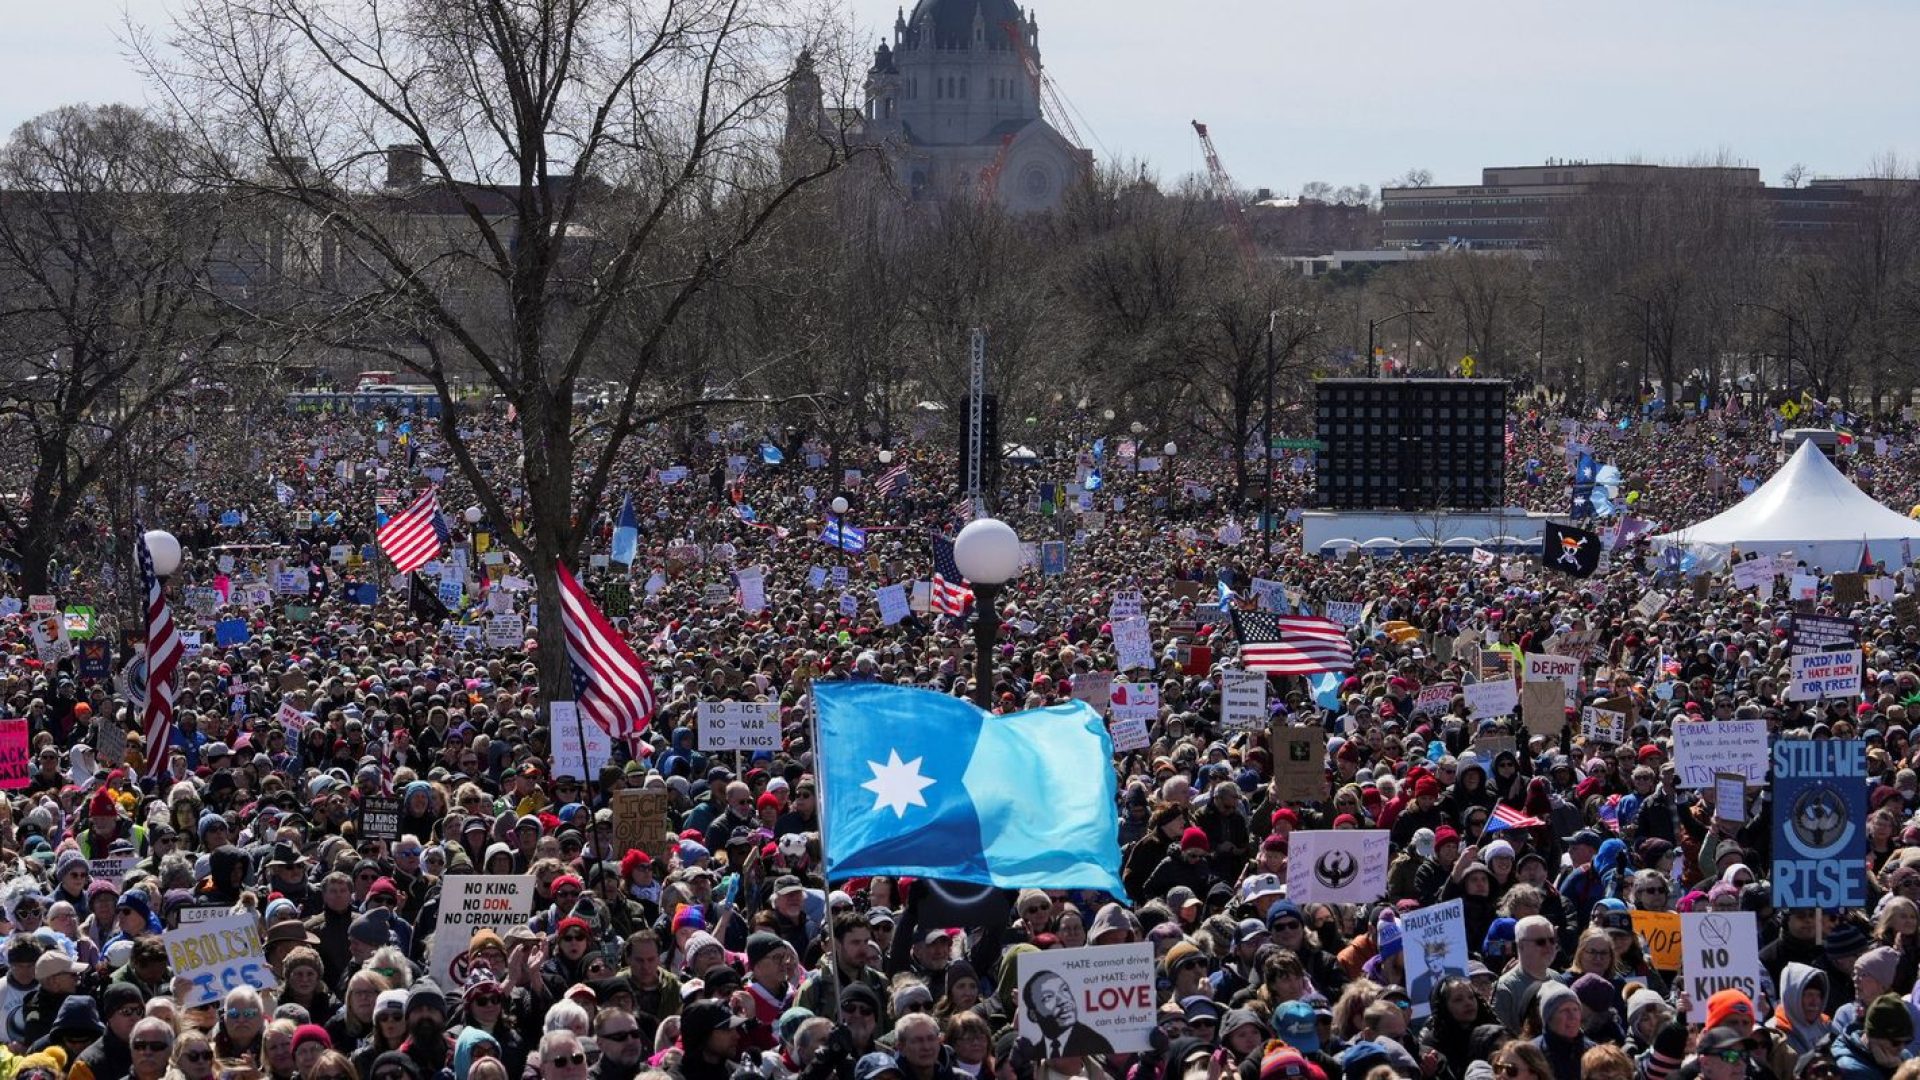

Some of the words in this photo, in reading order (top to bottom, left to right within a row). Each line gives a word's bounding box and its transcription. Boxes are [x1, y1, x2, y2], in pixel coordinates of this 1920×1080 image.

[1803, 654, 1832, 668] PAID?
[1835, 653, 1852, 665] NO
[1532, 661, 1576, 675] DEPORT
[1808, 668, 1831, 679] HATE
[1802, 682, 1824, 693] FOR
[1825, 678, 1857, 691] FREE!
[1420, 686, 1453, 702] PEOPLE
[710, 704, 726, 714] NO
[742, 704, 763, 714] ICE
[710, 719, 726, 729] NO
[740, 720, 765, 730] WAR
[1679, 724, 1713, 736] EQUAL
[1719, 723, 1755, 734] RIGHTS
[709, 736, 726, 746] NO
[740, 736, 773, 746] KINGS
[1773, 740, 1834, 779] STILL
[1834, 740, 1866, 777] WE
[619, 794, 667, 819] ICE
[363, 813, 375, 823] NO
[375, 813, 398, 825] KINGS
[370, 823, 398, 832] AMERICA
[616, 820, 664, 840] OUT
[92, 860, 122, 868] PROTECT
[464, 883, 482, 894] NO
[485, 883, 519, 894] KING.
[1773, 859, 1866, 908] RISE
[463, 899, 480, 910] NO
[483, 899, 512, 911] DON.
[444, 913, 462, 924] NO
[465, 913, 529, 924] CROWNED
[1404, 905, 1460, 932] FAUX-KING
[1422, 923, 1444, 939] JOKE
[170, 925, 263, 975] ABOLISH
[1093, 957, 1124, 968] cannot
[1126, 955, 1149, 965] drive
[1701, 949, 1729, 969] NO
[192, 963, 263, 1002] ICE
[1083, 974, 1099, 984] out
[1130, 971, 1149, 982] only
[1085, 984, 1152, 1013] LOVE
[1095, 1018, 1112, 1027] can
[1114, 1015, 1127, 1024] do
